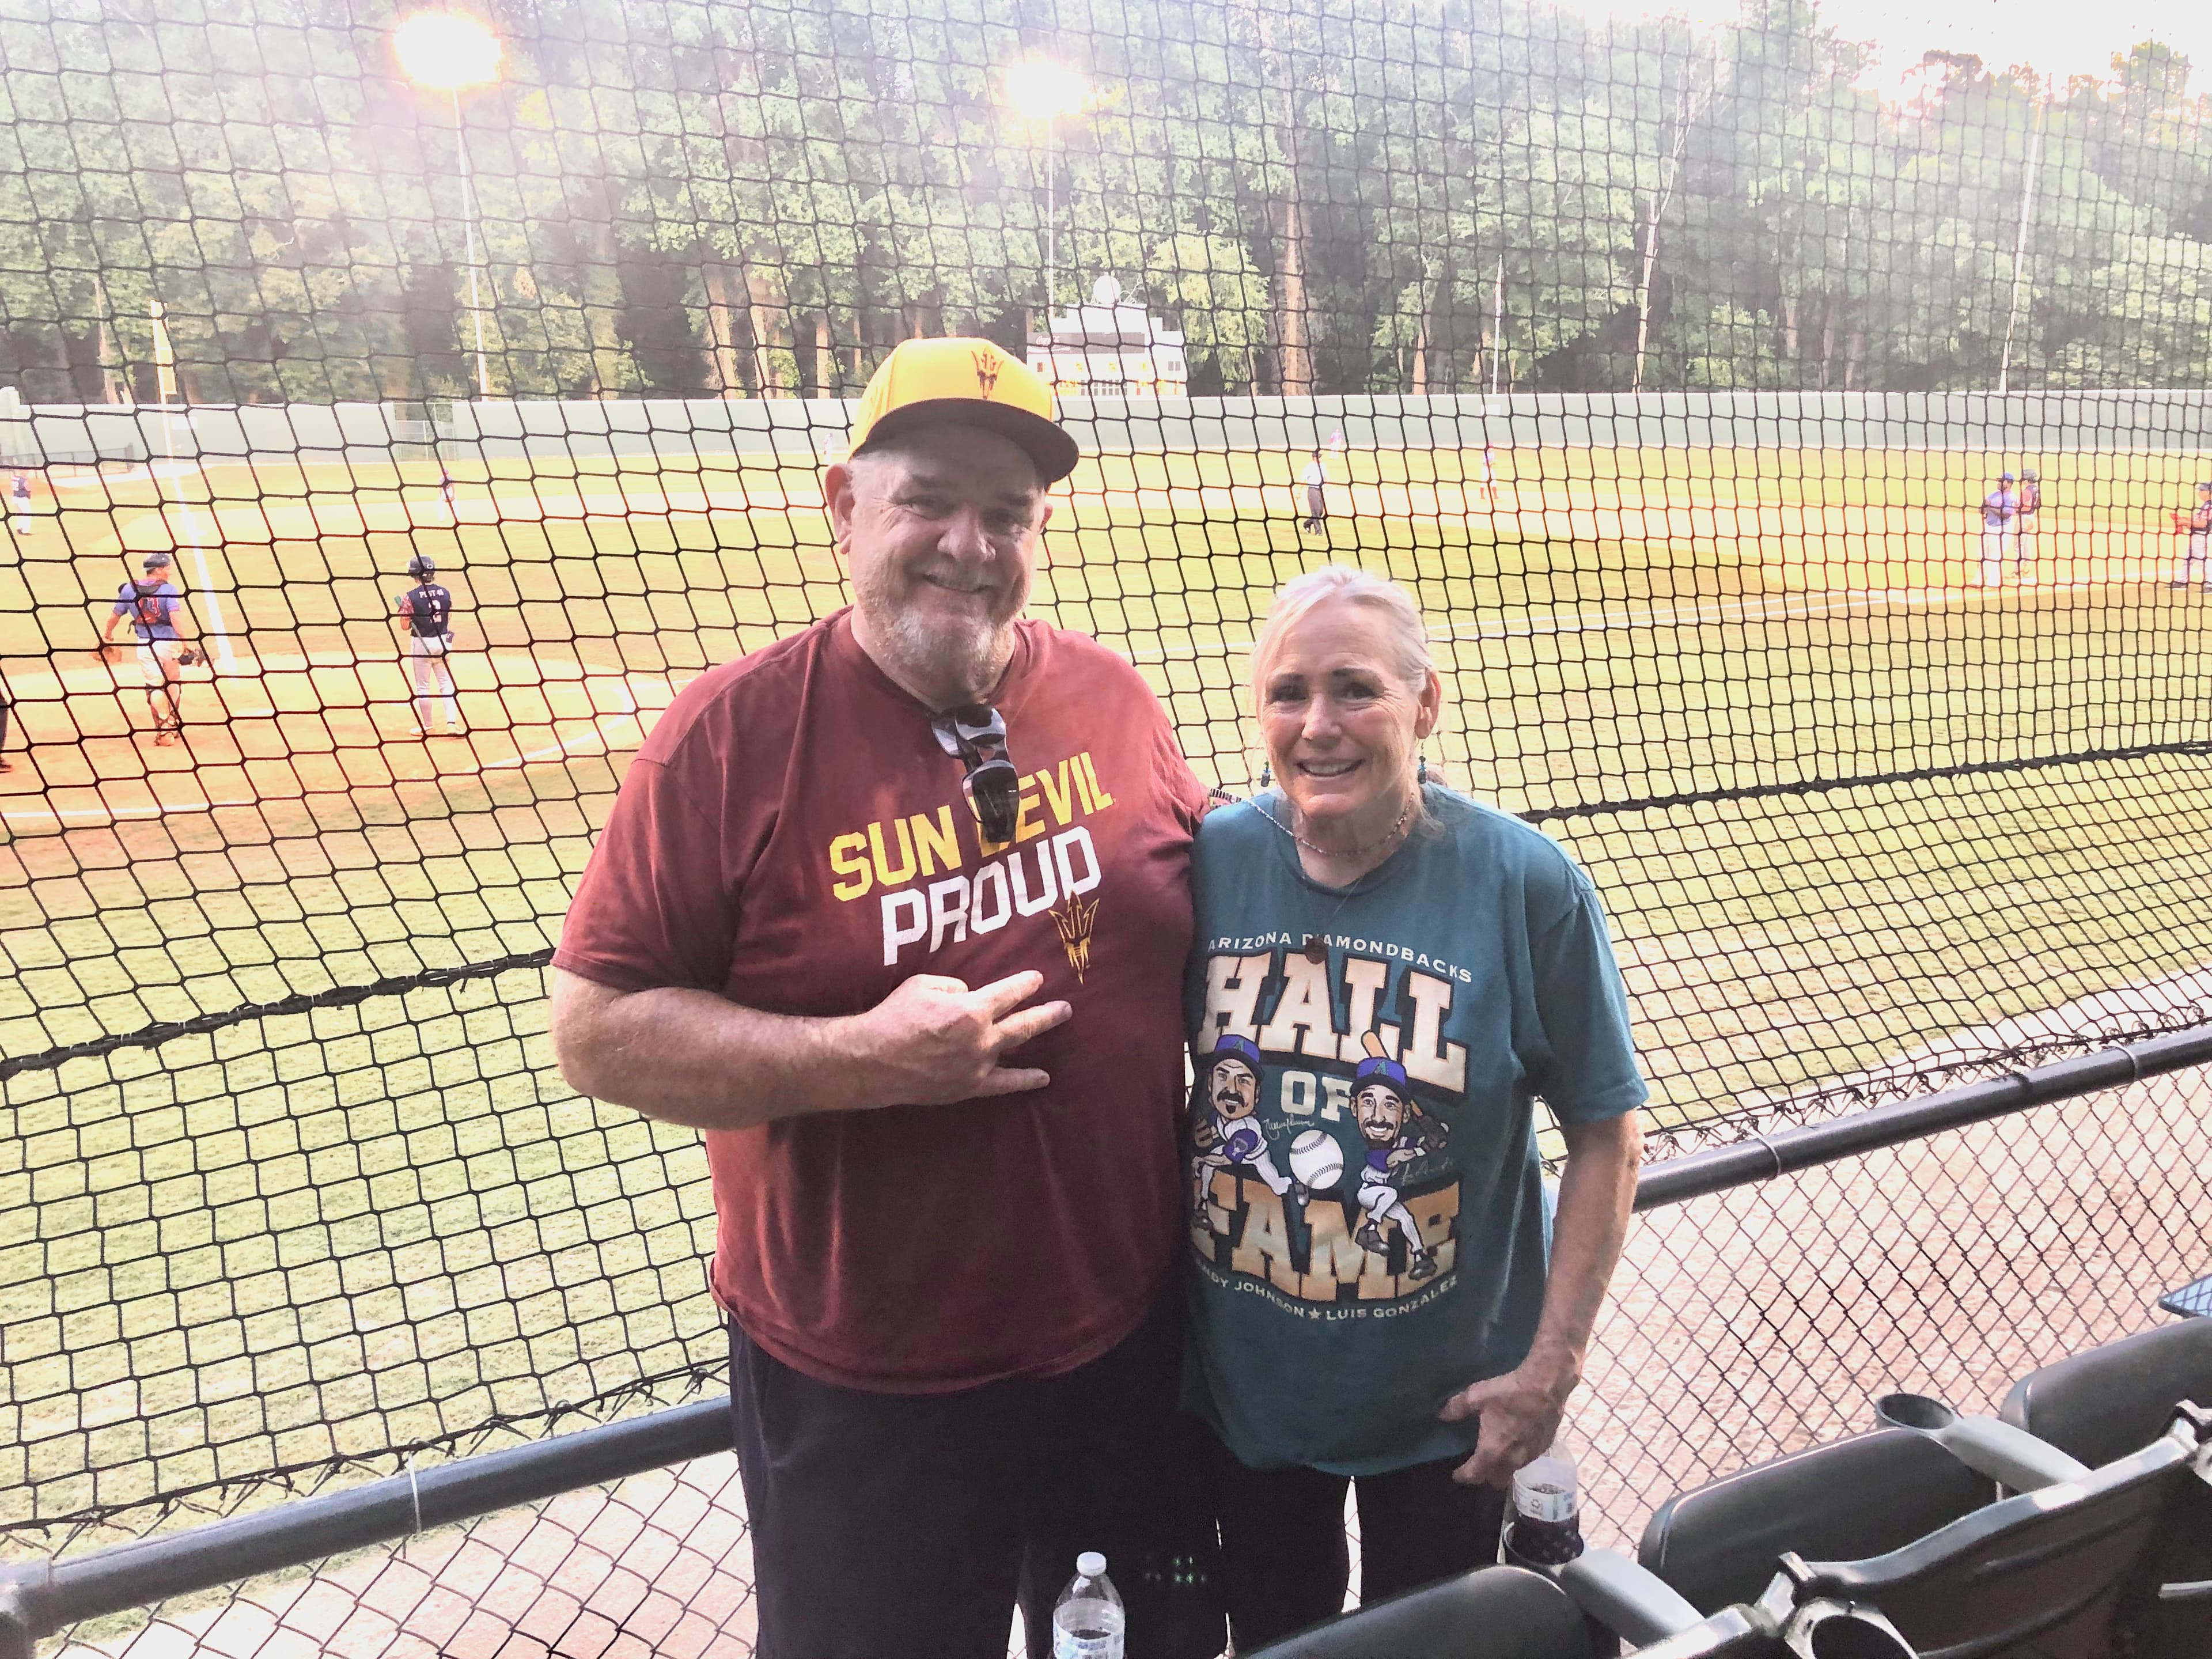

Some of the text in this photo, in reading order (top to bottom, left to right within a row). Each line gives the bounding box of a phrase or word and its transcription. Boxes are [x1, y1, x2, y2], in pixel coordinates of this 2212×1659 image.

[830, 805, 963, 902] SUN
[880, 826, 1101, 966] PROUD
[1208, 931, 1472, 983] ARIZONA DAMONDBACKS
[1197, 951, 1467, 1093] HALL
[1281, 1070, 1353, 1122] OF
[1191, 1170, 1460, 1301] FAME
[1234, 1281, 1305, 1318] JOHNSON
[1326, 1308, 1367, 1320] LUIS
[1373, 1275, 1457, 1319] GONZALEZ
